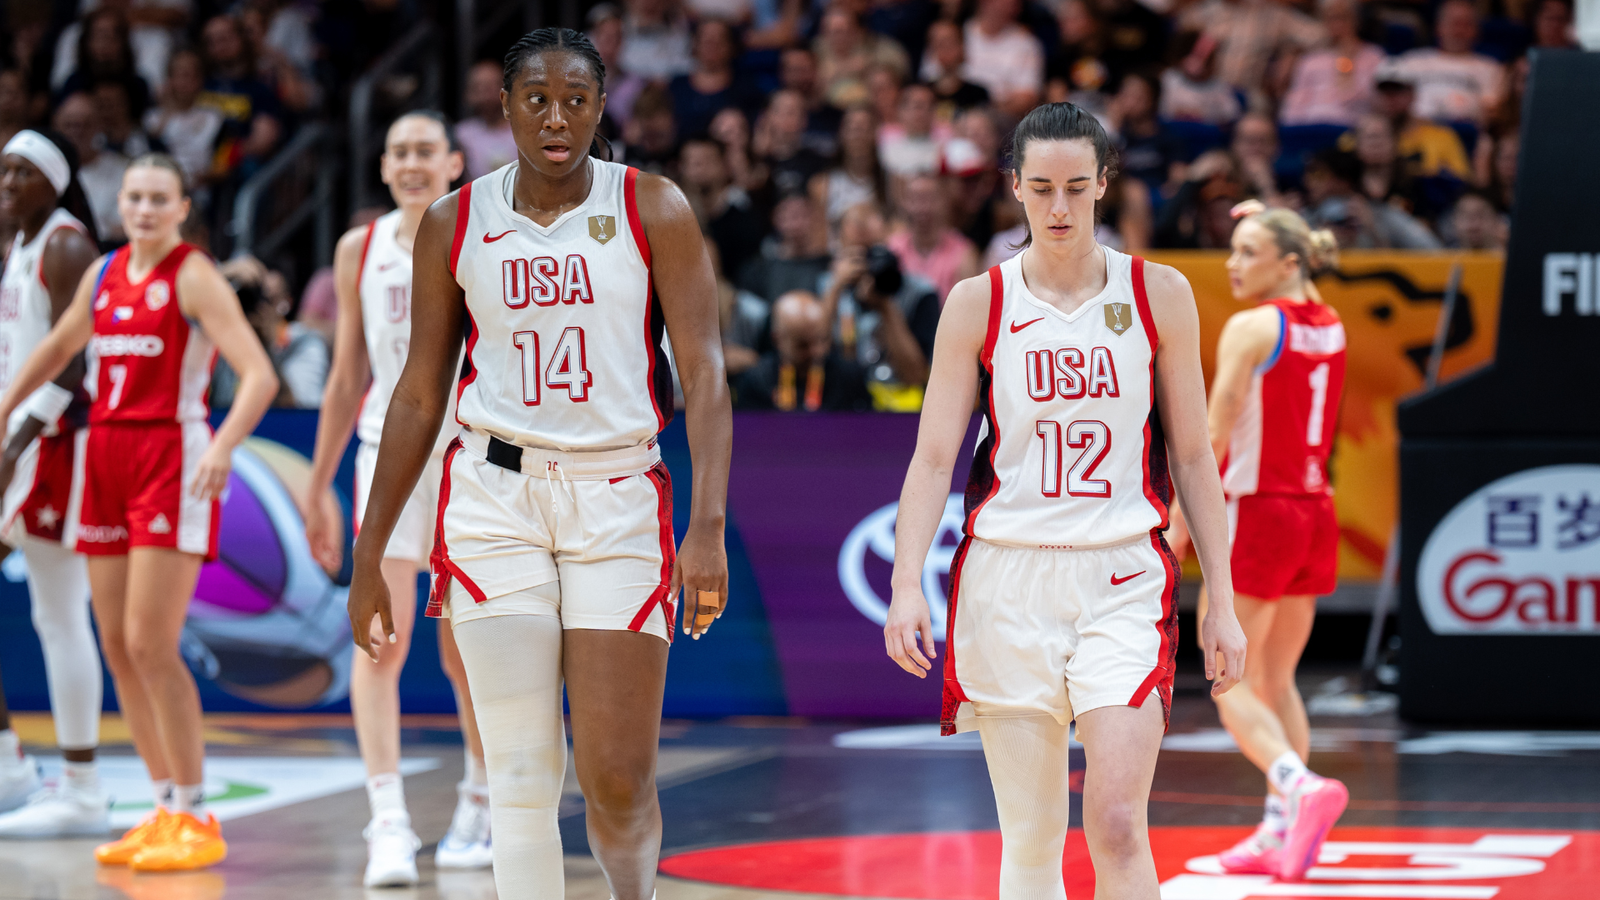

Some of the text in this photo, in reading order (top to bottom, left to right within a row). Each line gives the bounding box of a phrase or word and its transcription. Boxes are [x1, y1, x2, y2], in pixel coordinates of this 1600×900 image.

[502, 254, 594, 309] USA
[1543, 252, 1600, 317] FI
[108, 364, 127, 410] 7
[513, 326, 593, 406] 14
[1026, 346, 1120, 402] USA
[1307, 362, 1330, 446] 1
[1036, 419, 1112, 498] 12
[1487, 493, 1600, 551] 百岁
